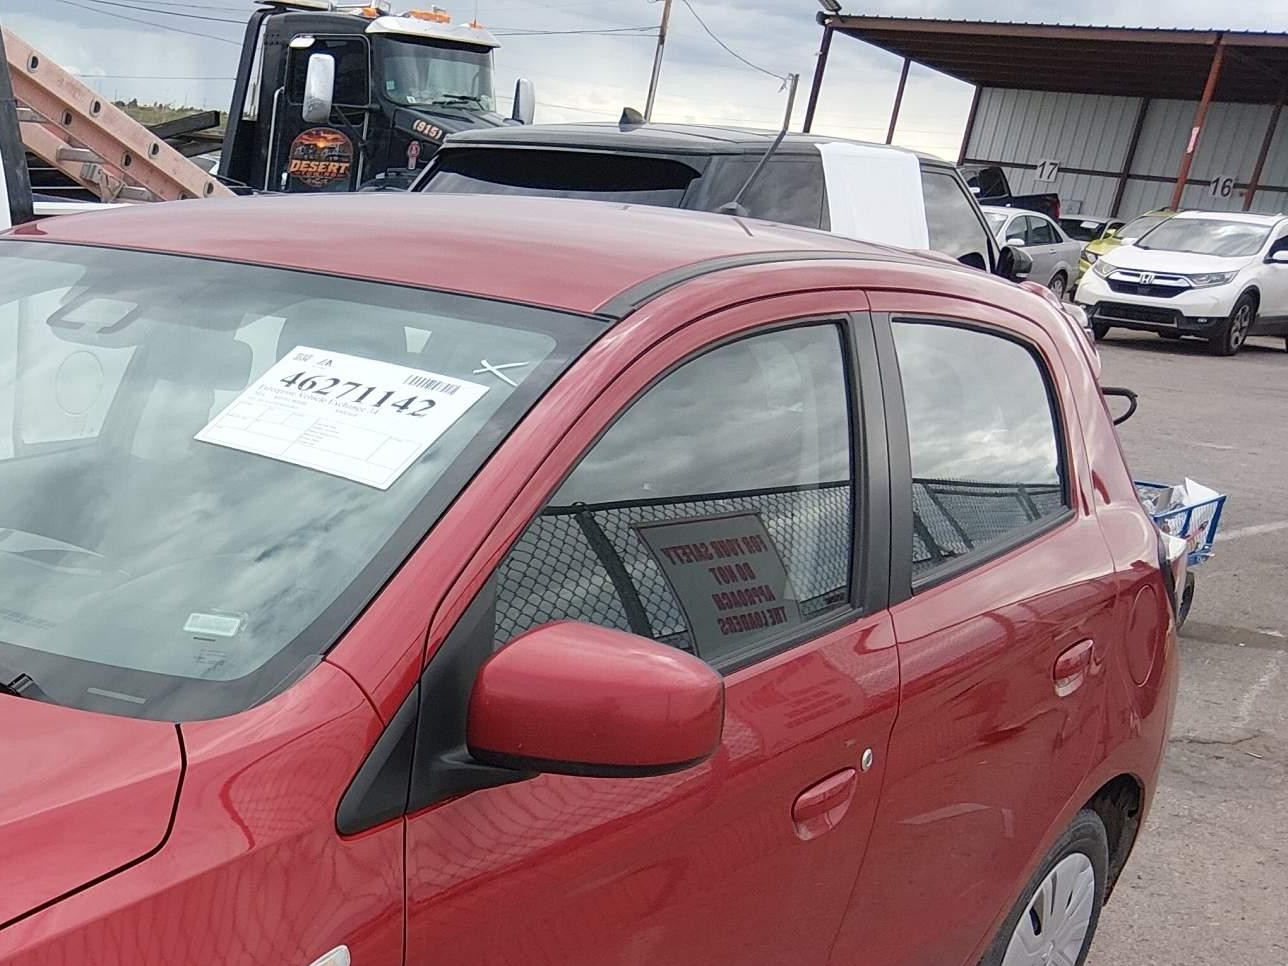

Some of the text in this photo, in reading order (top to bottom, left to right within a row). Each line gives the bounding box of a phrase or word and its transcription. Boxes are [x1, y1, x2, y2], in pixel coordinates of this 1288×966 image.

[412, 119, 443, 140] (915)
[290, 160, 351, 174] DESERT
[1038, 161, 1059, 180] 17
[1212, 177, 1234, 197] 16
[280, 371, 437, 418] 46271142
